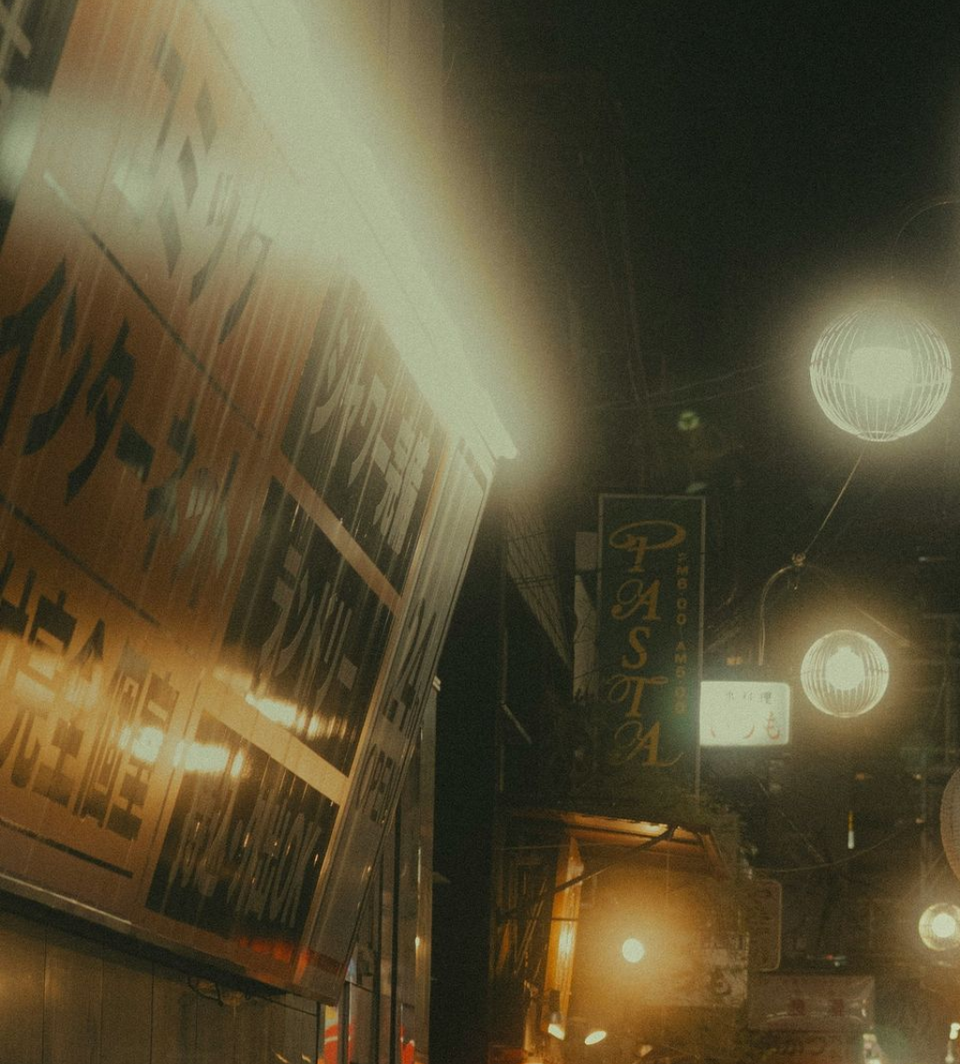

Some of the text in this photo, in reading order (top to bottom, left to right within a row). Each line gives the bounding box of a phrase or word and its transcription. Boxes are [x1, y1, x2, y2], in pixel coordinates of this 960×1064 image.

[307, 314, 430, 561] シャワー完備
[255, 557, 361, 720] ランドリー
[607, 519, 687, 767] PASTA
[354, 743, 397, 829] OPEN
